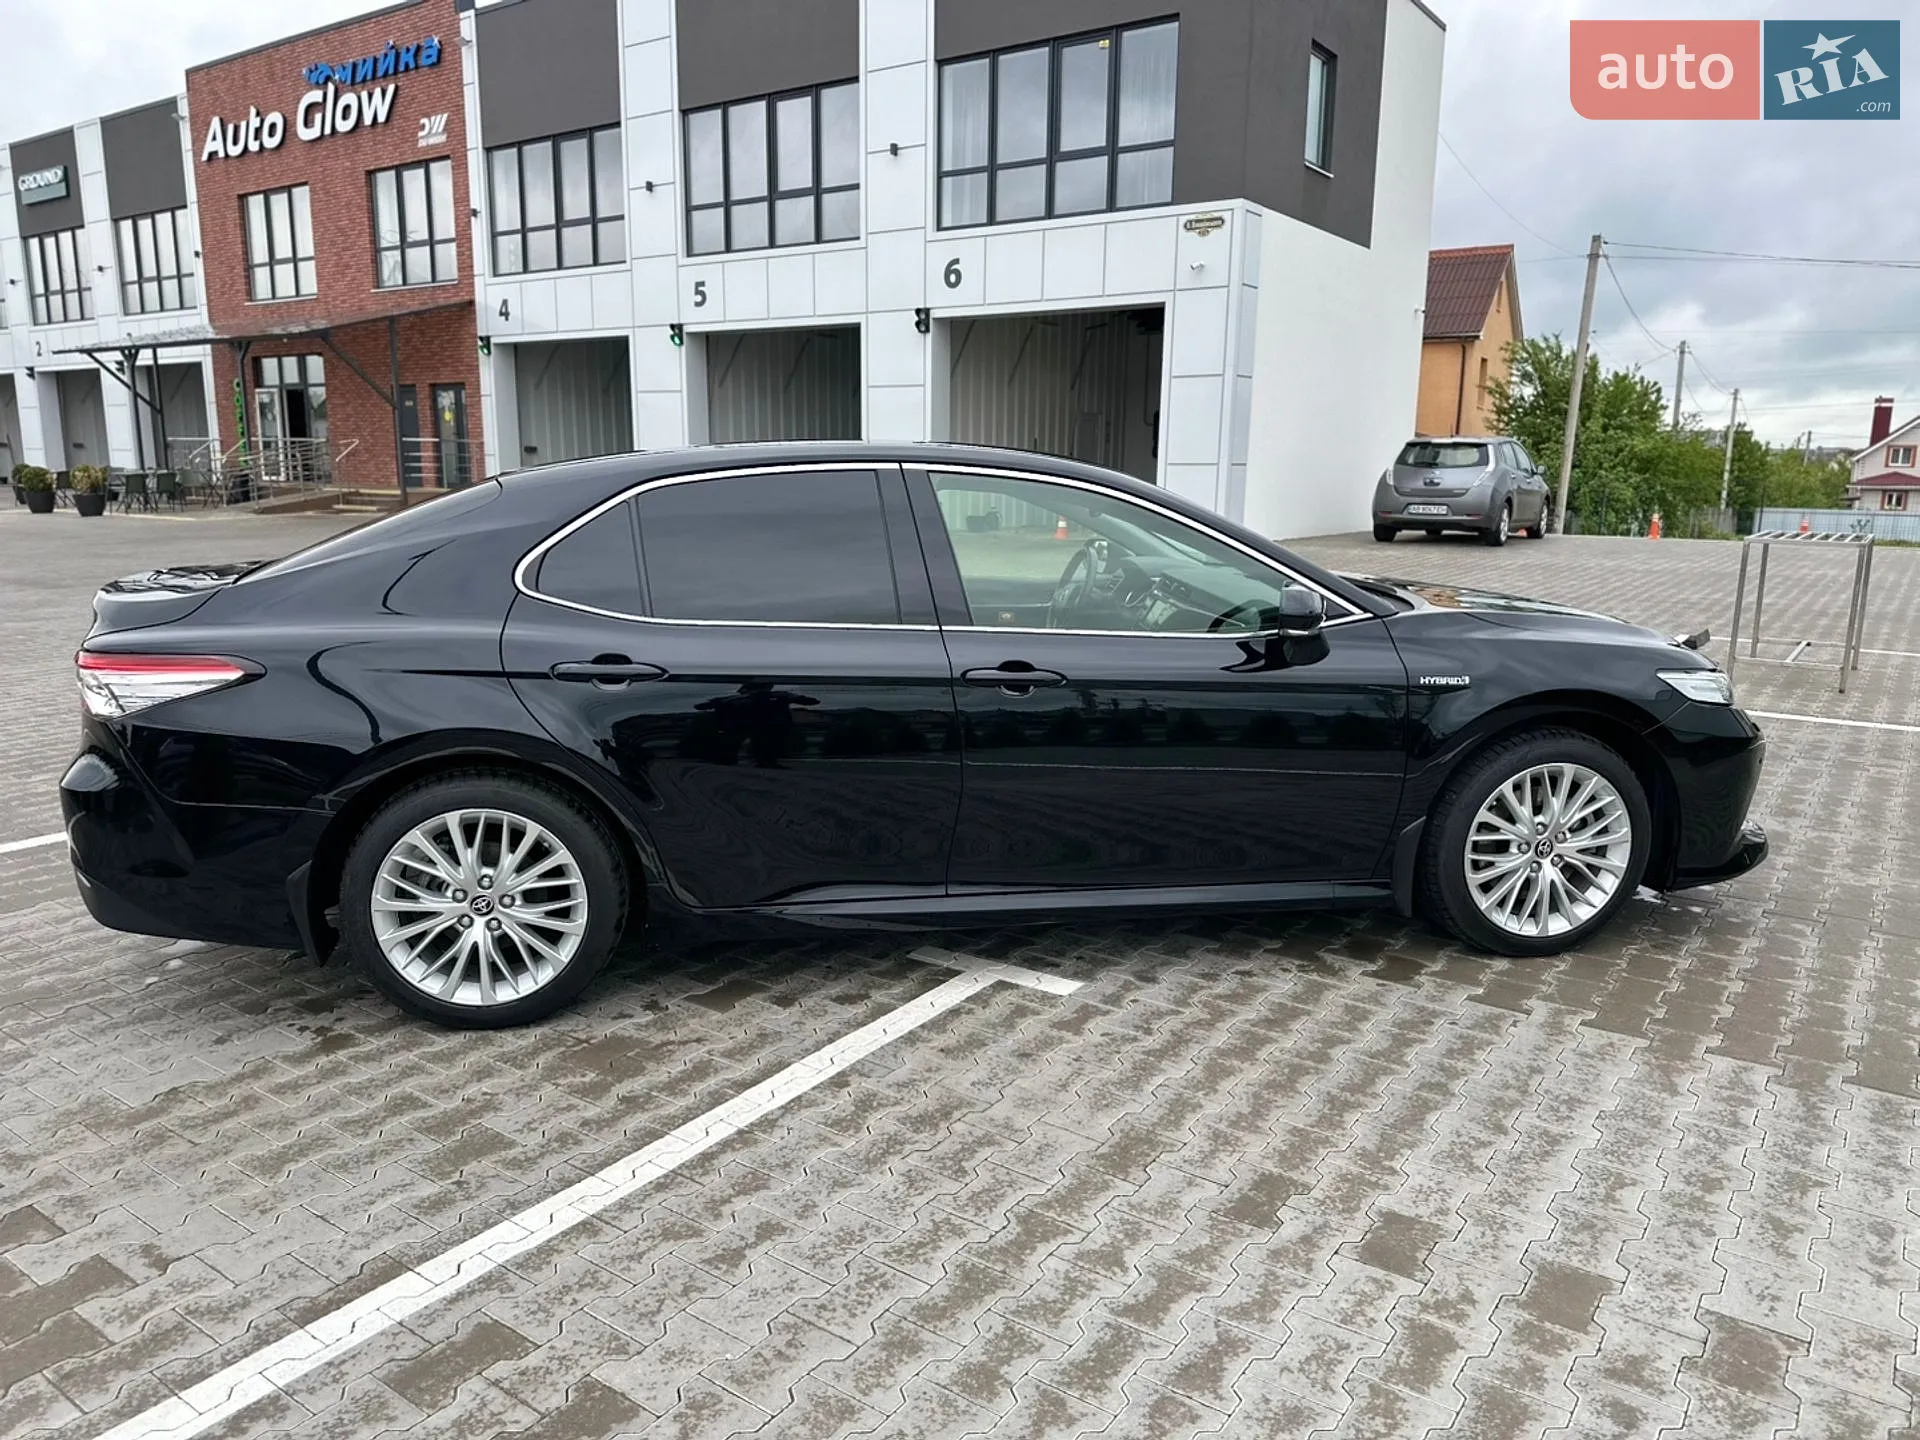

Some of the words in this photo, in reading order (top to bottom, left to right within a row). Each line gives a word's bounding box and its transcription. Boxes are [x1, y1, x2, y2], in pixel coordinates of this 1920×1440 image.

[202, 105, 284, 161] Auto
[296, 81, 395, 142] Glow
[944, 257, 962, 289] 6
[694, 281, 707, 307] 5
[499, 299, 510, 321] 4
[36, 341, 42, 357] 2
